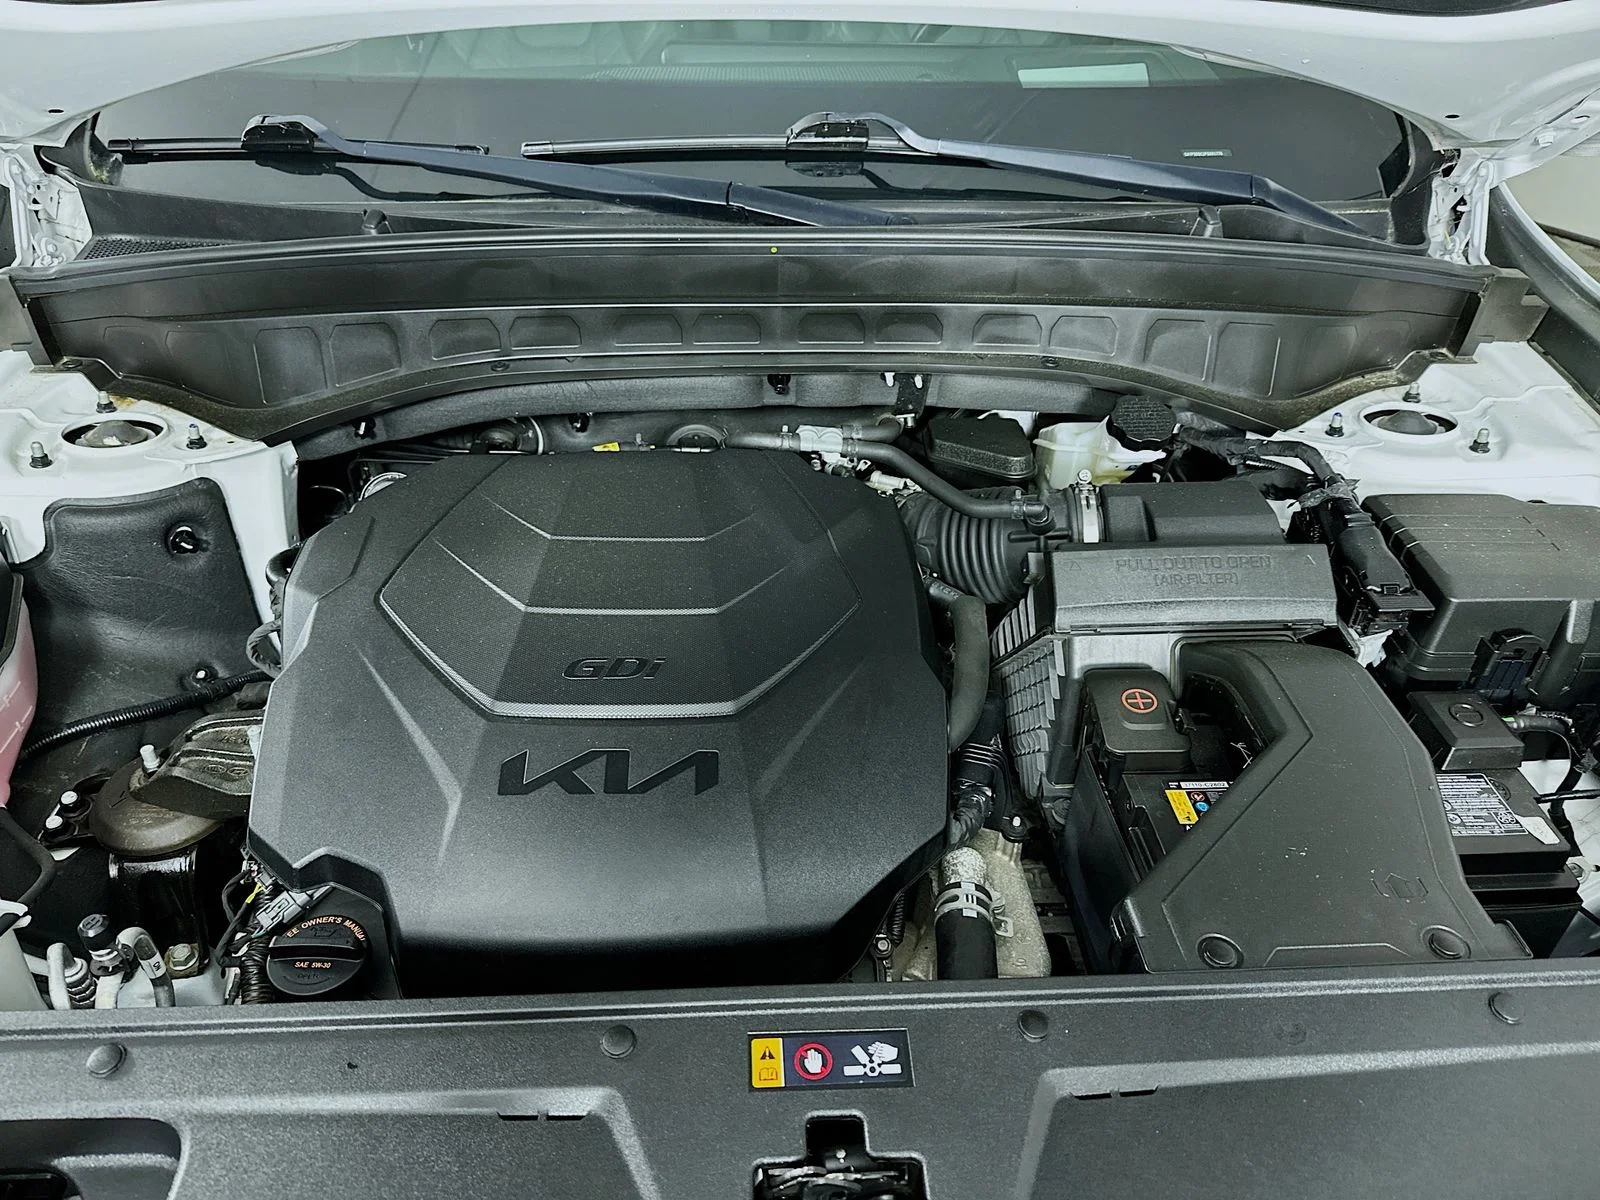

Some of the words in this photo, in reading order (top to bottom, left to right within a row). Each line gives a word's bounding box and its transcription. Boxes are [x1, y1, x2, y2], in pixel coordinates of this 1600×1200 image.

[1115, 557, 1158, 572] PULL
[1162, 556, 1201, 570] OUT
[1202, 555, 1224, 570] TO
[1227, 554, 1272, 569] OPEN
[562, 657, 667, 680] GDi
[498, 749, 719, 796] KIA
[286, 927, 300, 938] EE
[301, 916, 343, 929] OWNER'S
[311, 961, 332, 969] 5W-30
